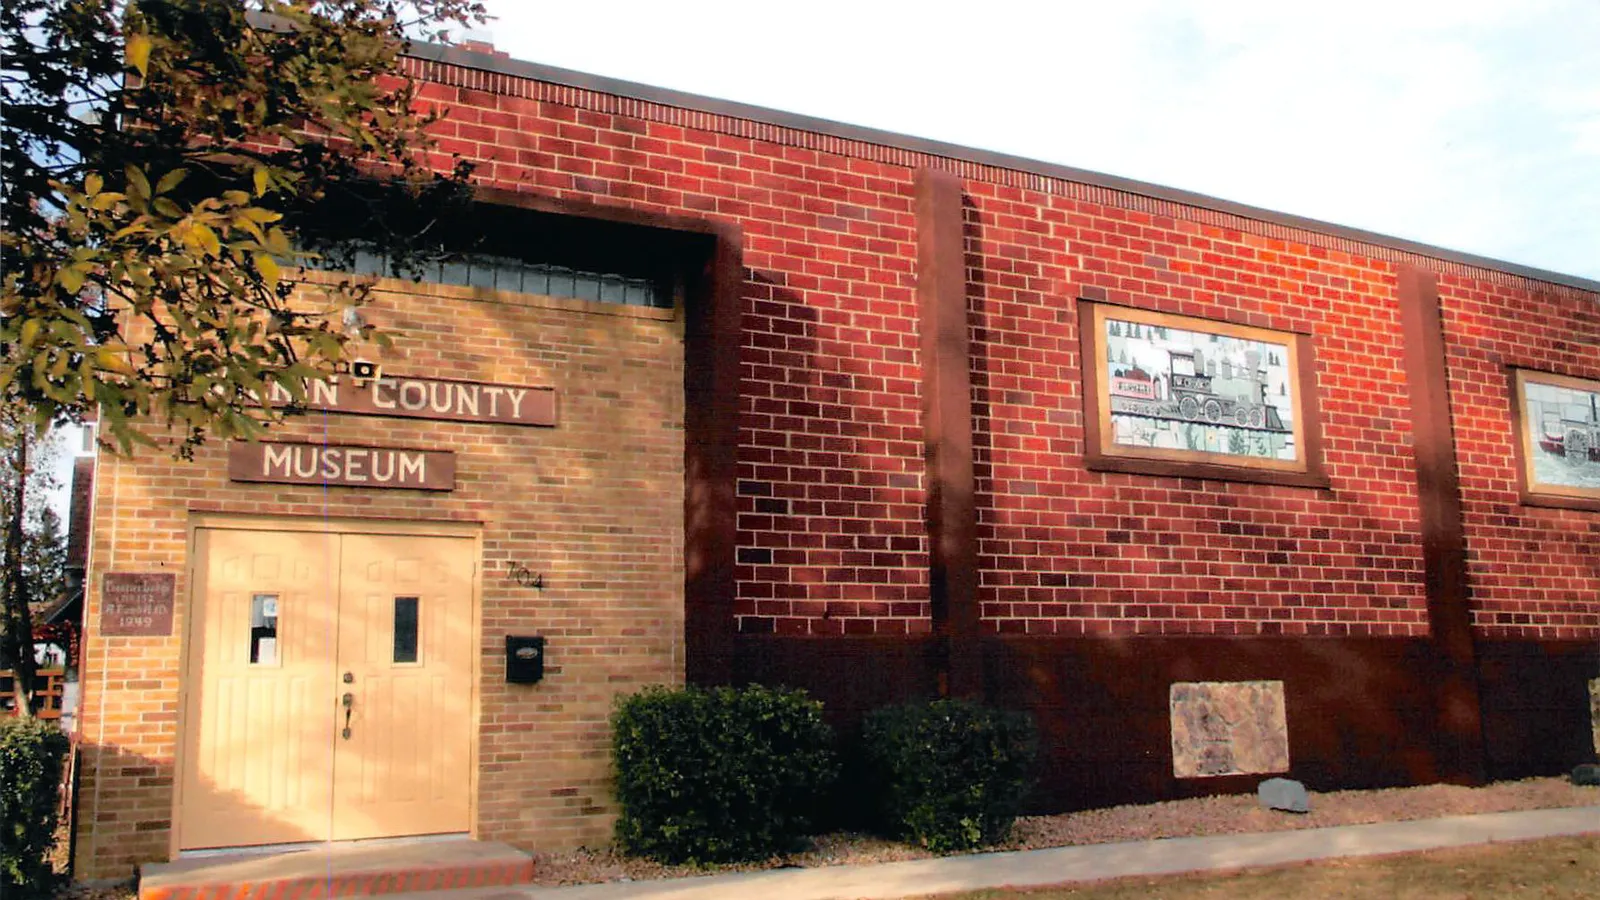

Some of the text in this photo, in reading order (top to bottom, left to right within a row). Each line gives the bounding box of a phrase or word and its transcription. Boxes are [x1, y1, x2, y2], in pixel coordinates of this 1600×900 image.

[371, 379, 527, 419] COUNTY
[263, 444, 426, 483] MUSEUM
[506, 560, 547, 591] 704
